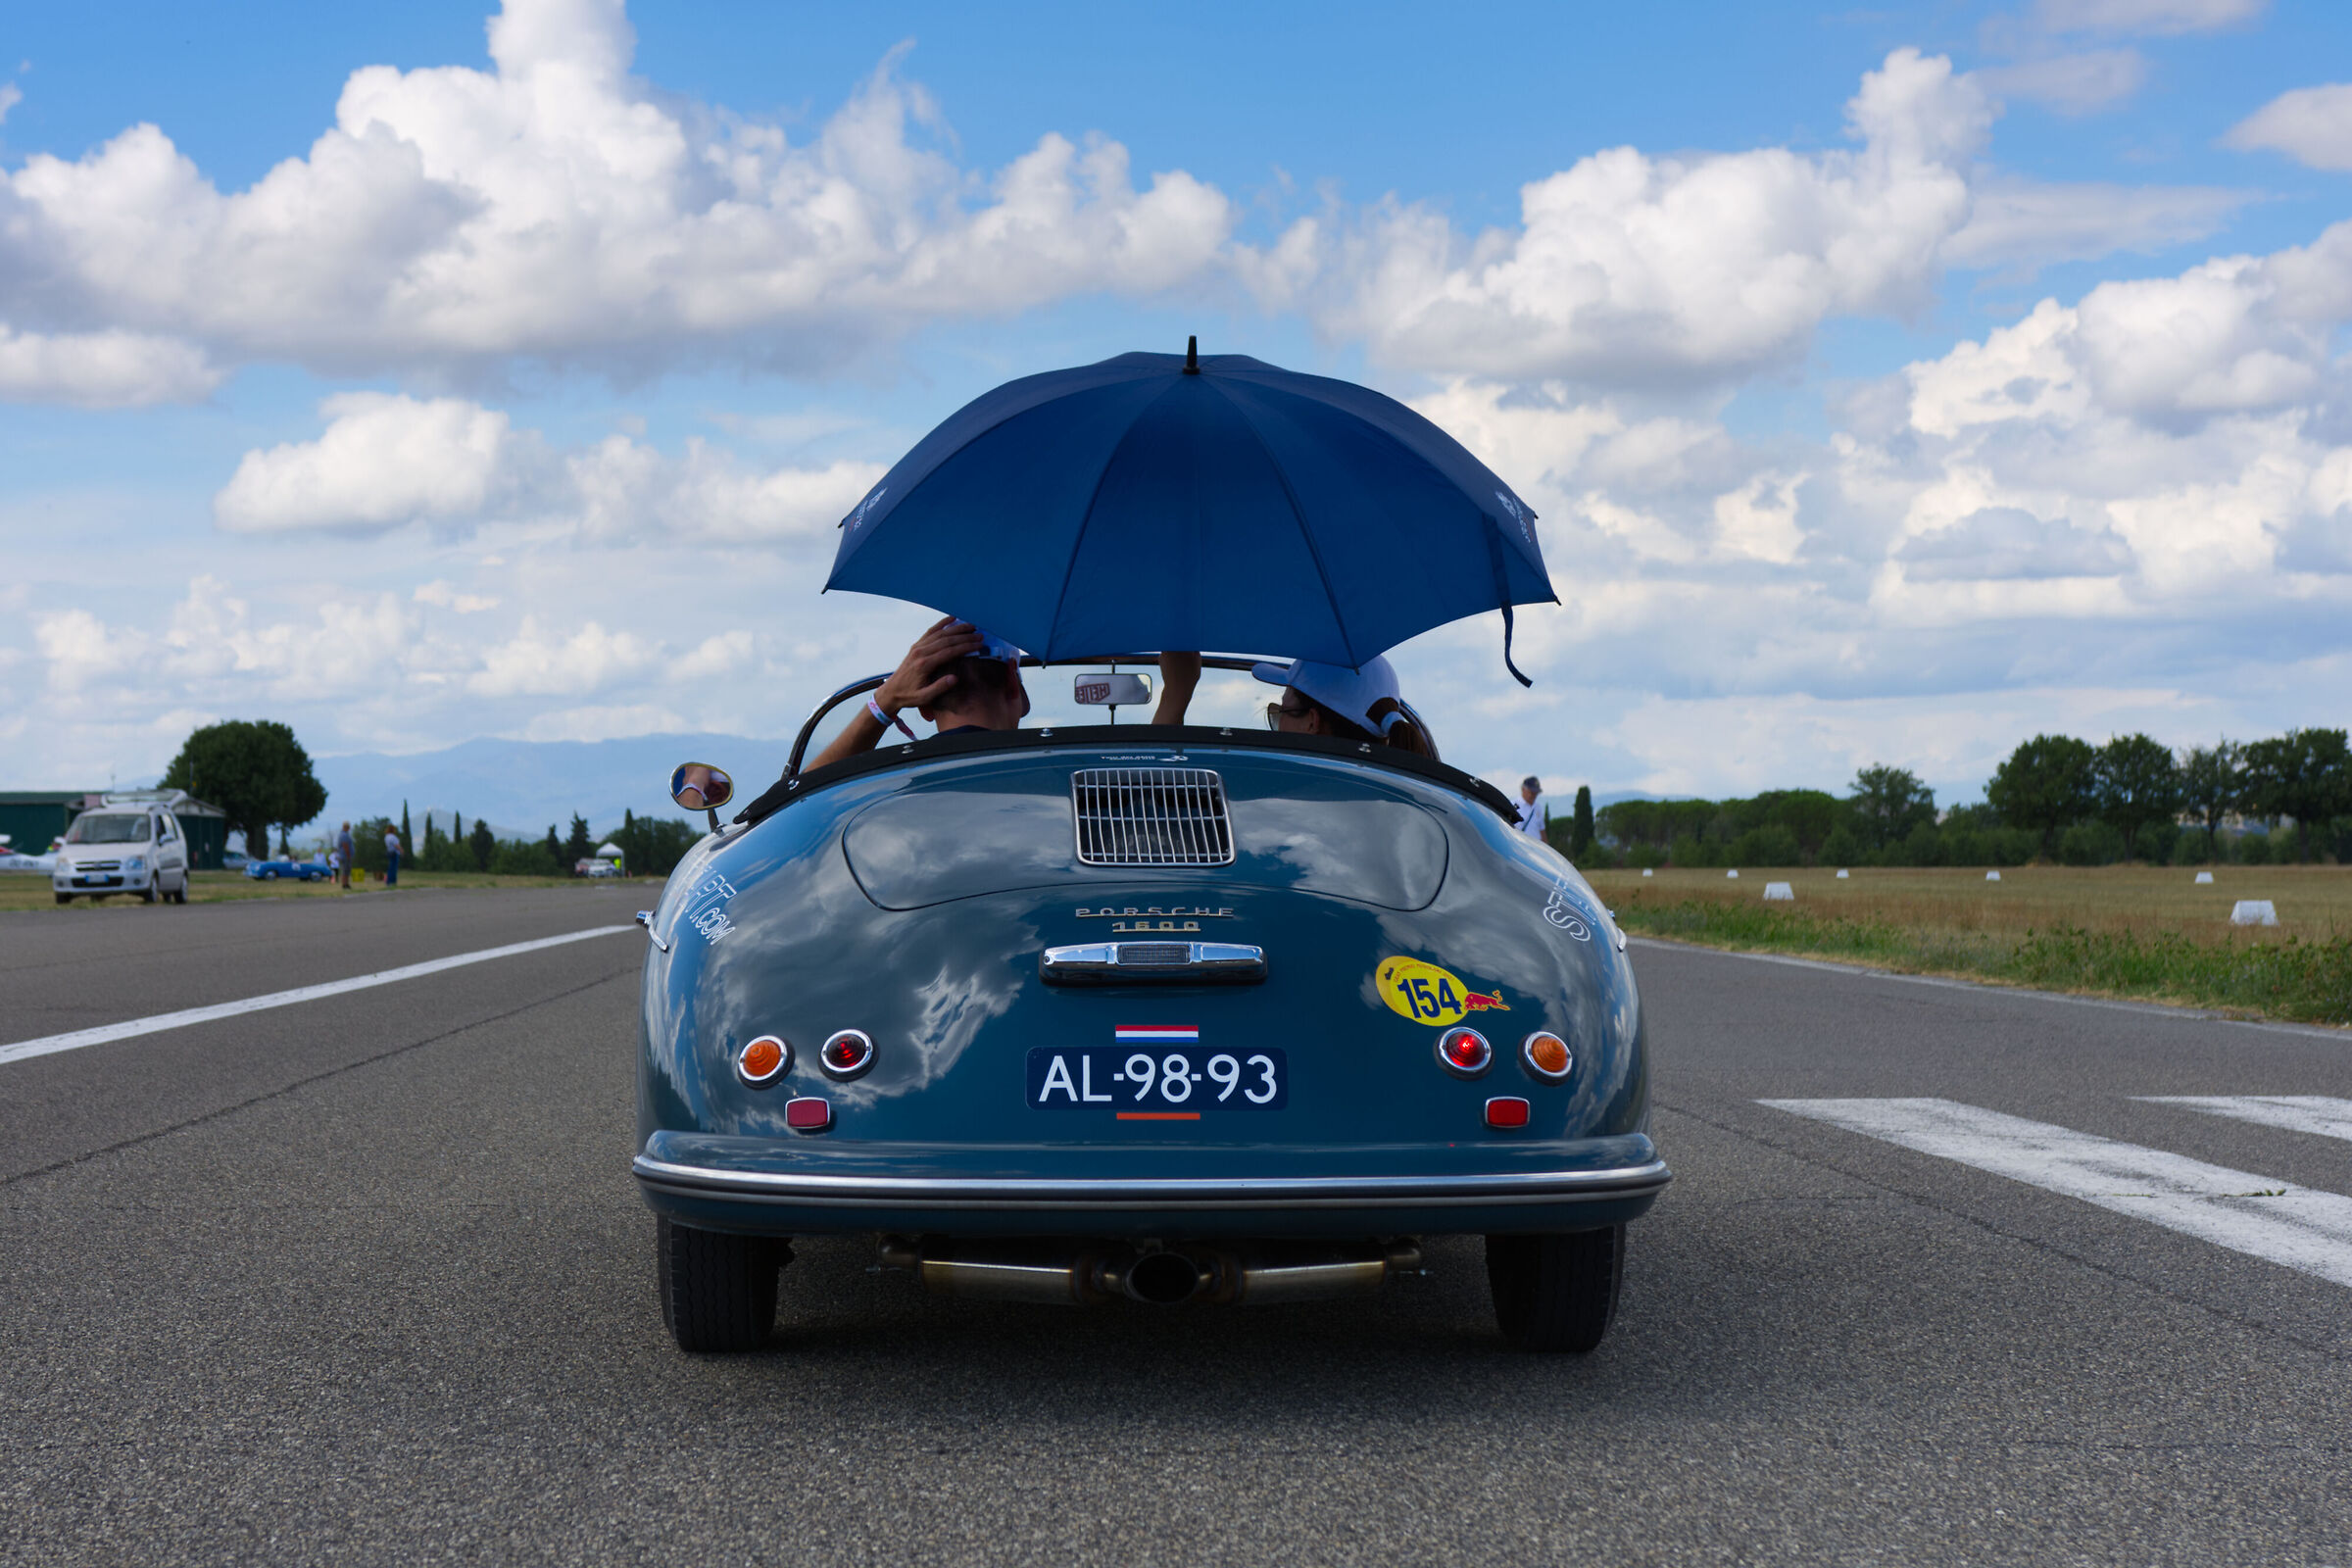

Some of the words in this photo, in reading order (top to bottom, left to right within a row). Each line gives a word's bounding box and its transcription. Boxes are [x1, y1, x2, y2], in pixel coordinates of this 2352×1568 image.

[1075, 906, 1234, 917] PORSCHE
[1112, 921, 1200, 932] 1600
[1397, 978, 1462, 1019] 154
[1039, 1054, 1277, 1103] AL-98-93
